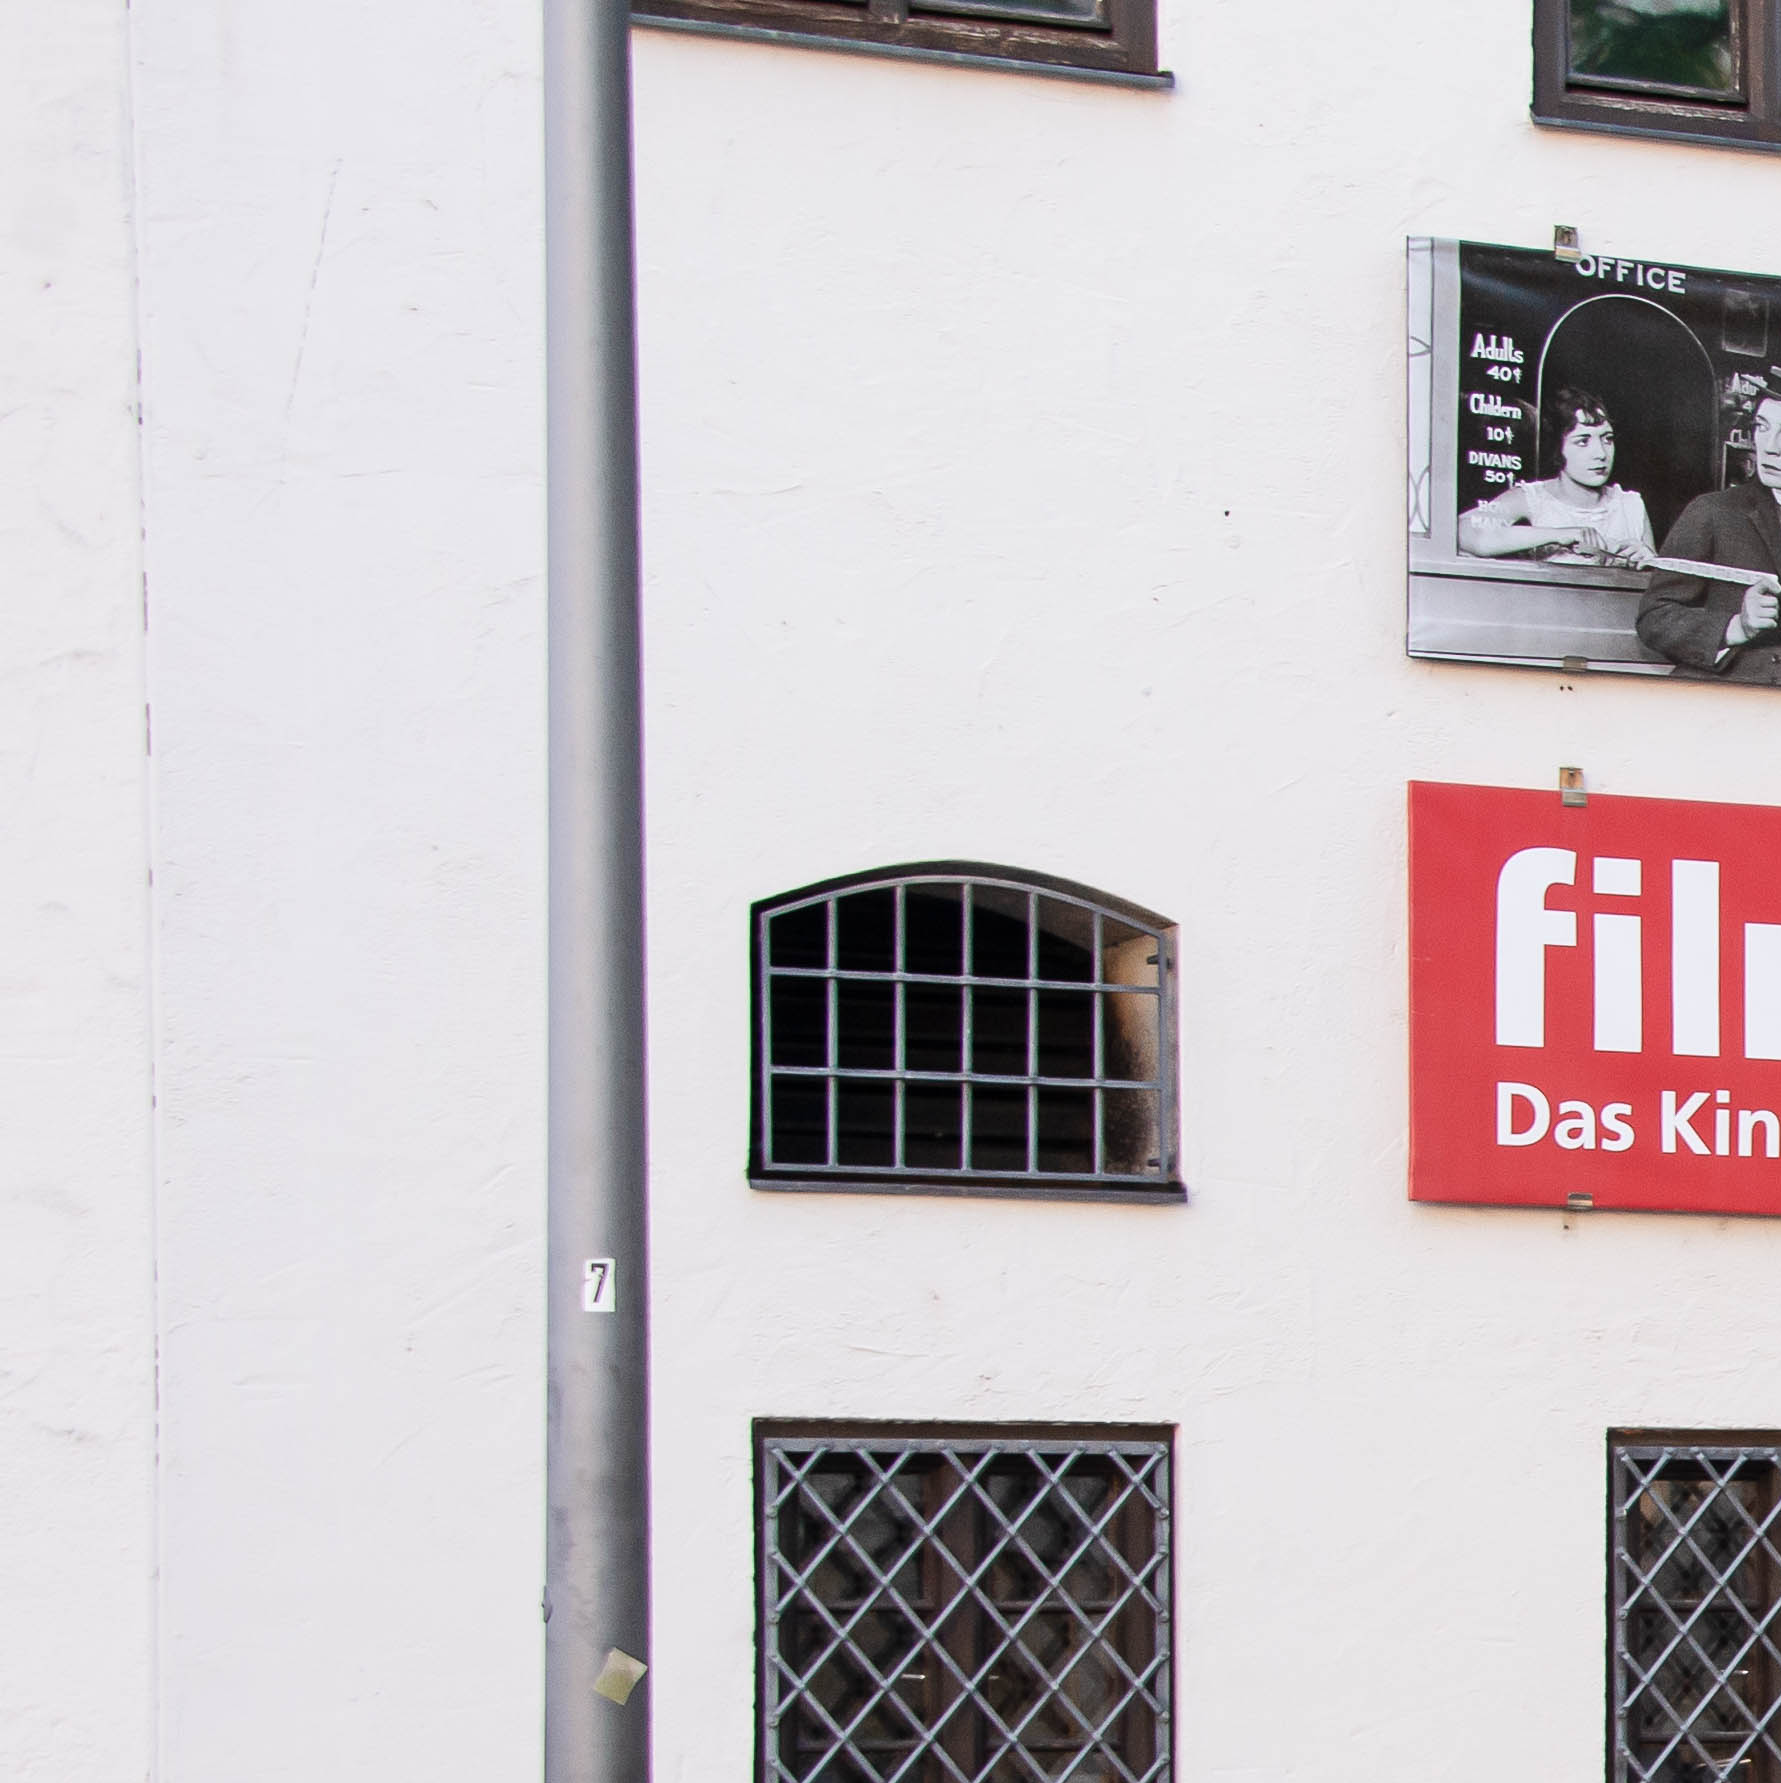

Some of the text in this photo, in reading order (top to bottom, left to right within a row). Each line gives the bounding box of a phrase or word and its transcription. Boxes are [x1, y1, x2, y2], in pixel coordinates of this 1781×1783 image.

[1575, 254, 1686, 294] OFFICE
[1470, 332, 1525, 364] Adults
[1468, 450, 1523, 471] DIVANS
[1496, 1081, 1635, 1152] Das
[590, 1262, 609, 1304] 7
